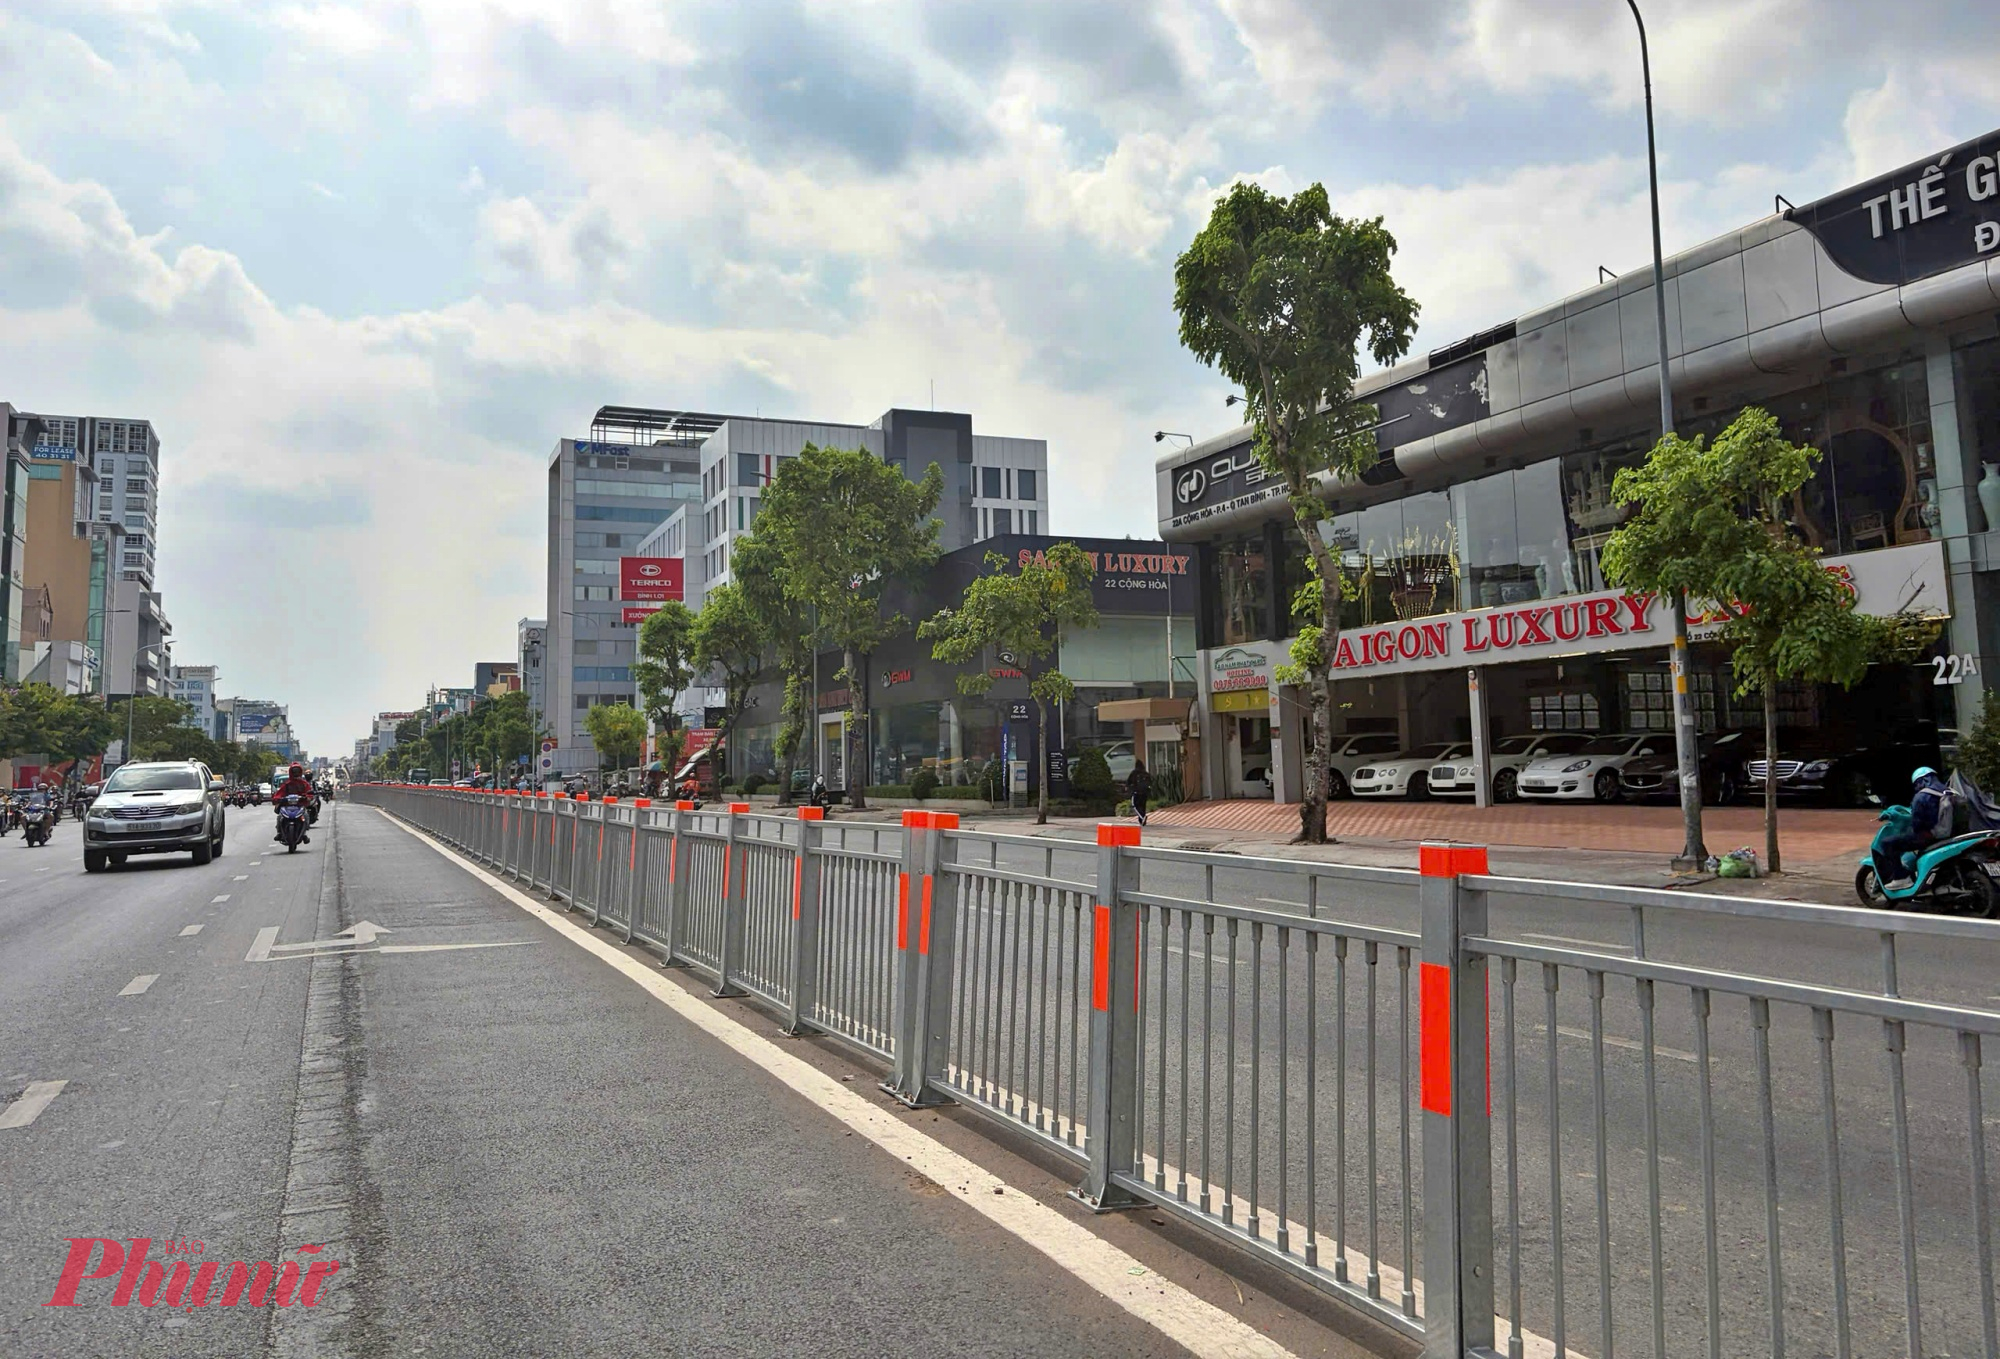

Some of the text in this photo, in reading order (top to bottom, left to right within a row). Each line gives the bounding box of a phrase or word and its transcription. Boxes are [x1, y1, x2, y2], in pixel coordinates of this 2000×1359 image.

[1862, 152, 1953, 239] THẾ
[50, 447, 74, 455] LEASE
[591, 442, 630, 456] MFast
[1104, 552, 1190, 575] LUXURY
[630, 579, 672, 587] TERACO
[1104, 579, 1116, 588] 22
[1118, 578, 1146, 590] CỘNG
[1461, 591, 1658, 652] LUXURY
[891, 668, 911, 684] GWM
[988, 668, 1022, 678] GWM
[1932, 653, 1977, 686] 22A
[1012, 705, 1026, 714] 22
